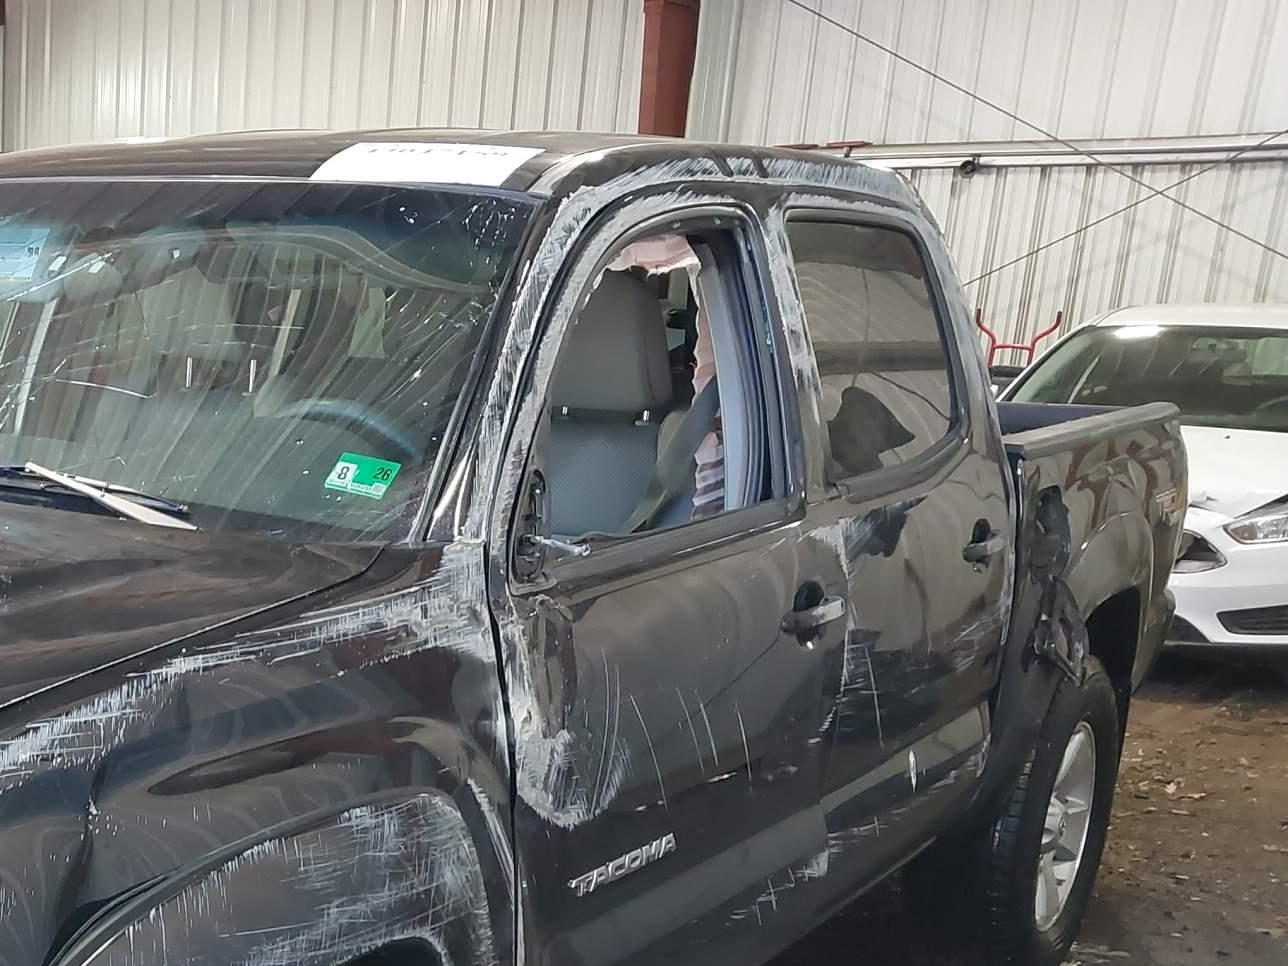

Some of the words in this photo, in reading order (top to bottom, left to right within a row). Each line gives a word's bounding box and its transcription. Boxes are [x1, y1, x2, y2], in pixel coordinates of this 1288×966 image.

[337, 466, 350, 480] 8
[373, 467, 393, 481] 26
[568, 832, 677, 897] TACOMA
